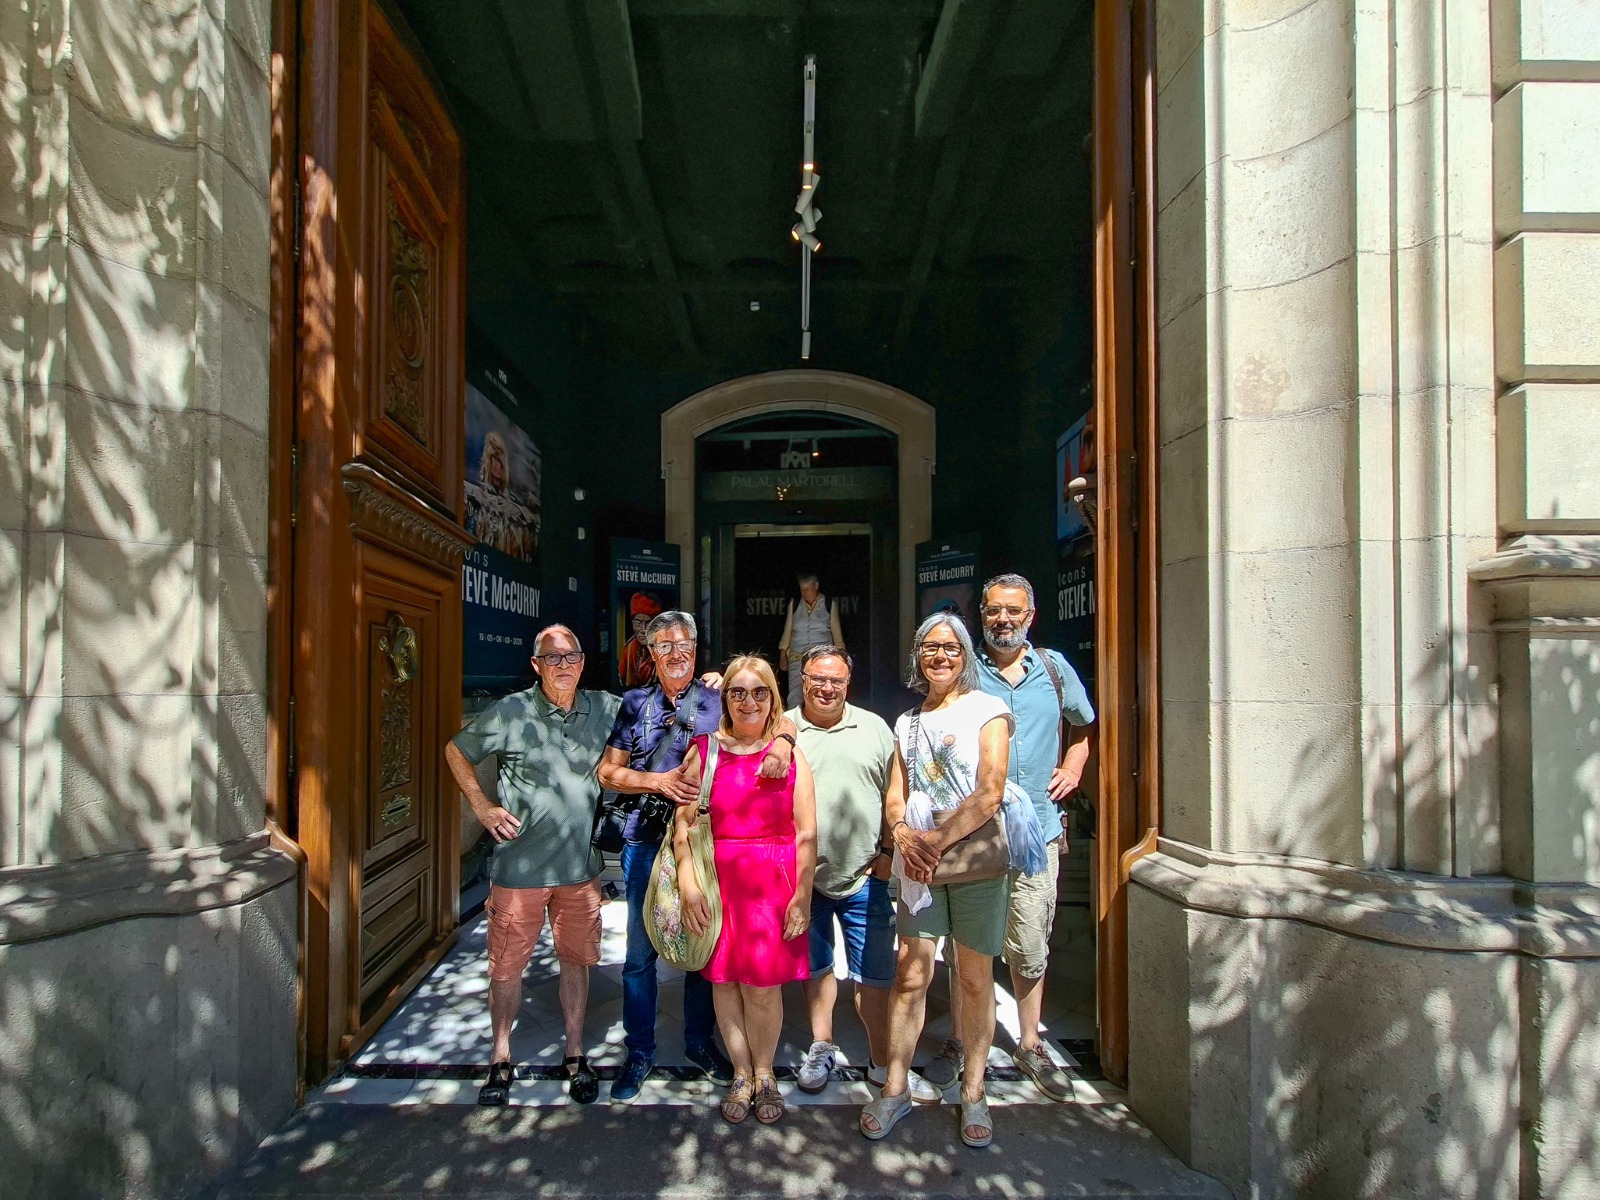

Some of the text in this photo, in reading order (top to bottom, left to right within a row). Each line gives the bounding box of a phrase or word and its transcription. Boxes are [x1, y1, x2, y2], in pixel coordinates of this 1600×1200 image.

[617, 570, 676, 586] STEVE McCURRY
[919, 565, 975, 584] STEVE McCURRY
[1058, 566, 1086, 587] Icons
[462, 564, 541, 618] TEVE McCURRY
[746, 597, 787, 616] STEVE
[1058, 582, 1087, 621] STEVE
